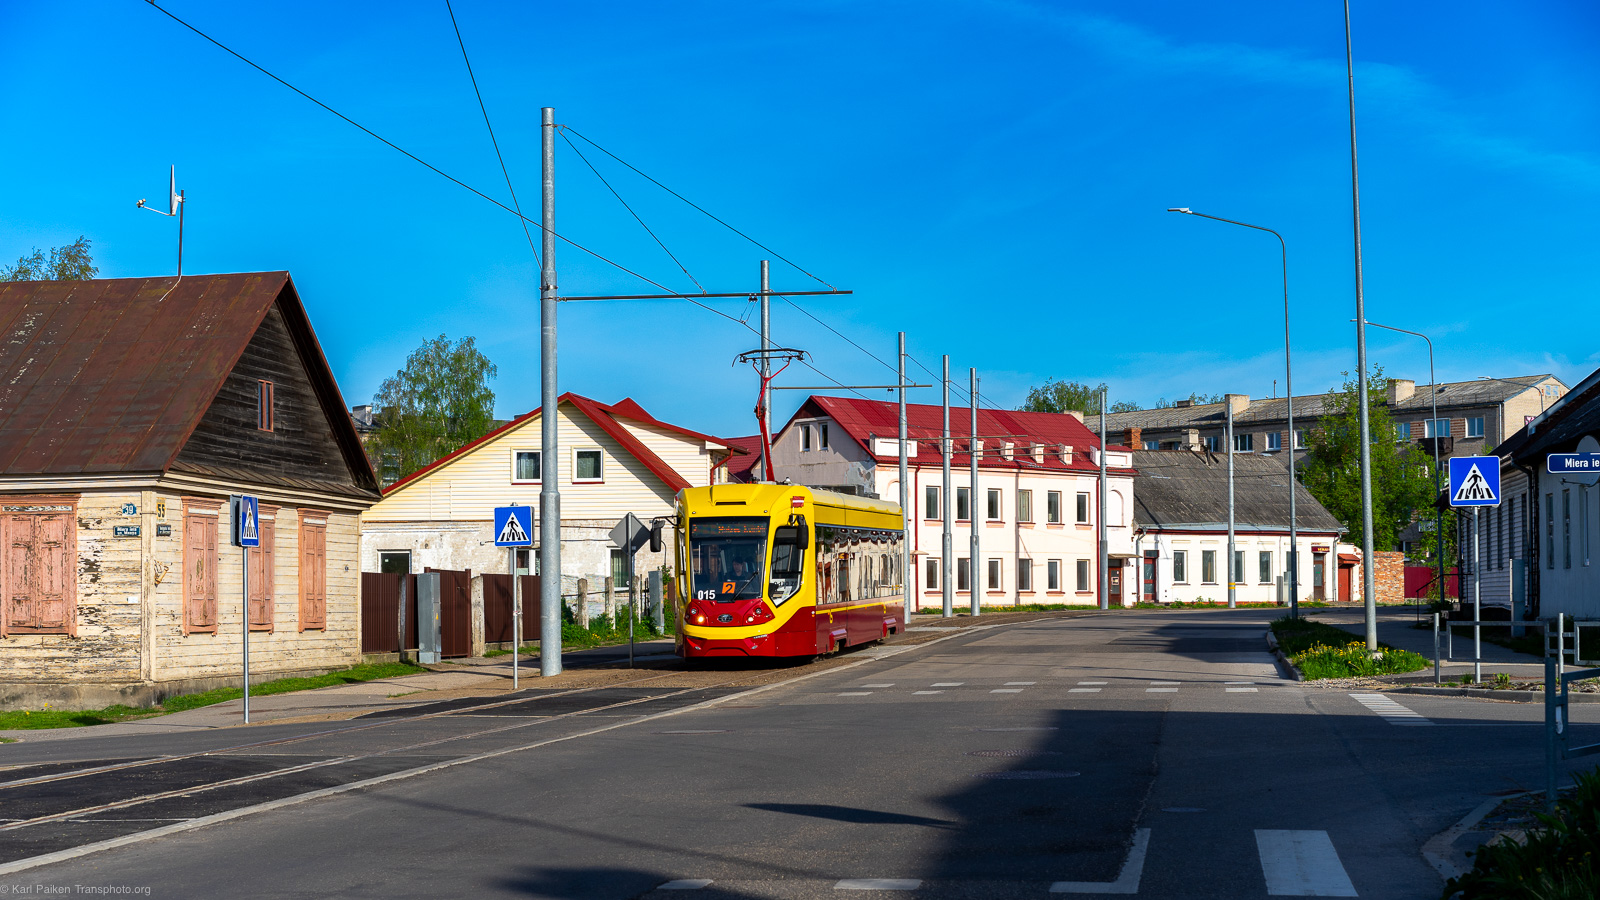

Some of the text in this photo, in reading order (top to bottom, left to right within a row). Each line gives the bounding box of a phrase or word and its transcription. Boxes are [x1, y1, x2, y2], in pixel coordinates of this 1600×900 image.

[1565, 458, 1588, 467] Miera
[123, 505, 133, 515] 39
[157, 503, 166, 518] 55
[725, 583, 734, 594] 2
[697, 589, 716, 601] 015
